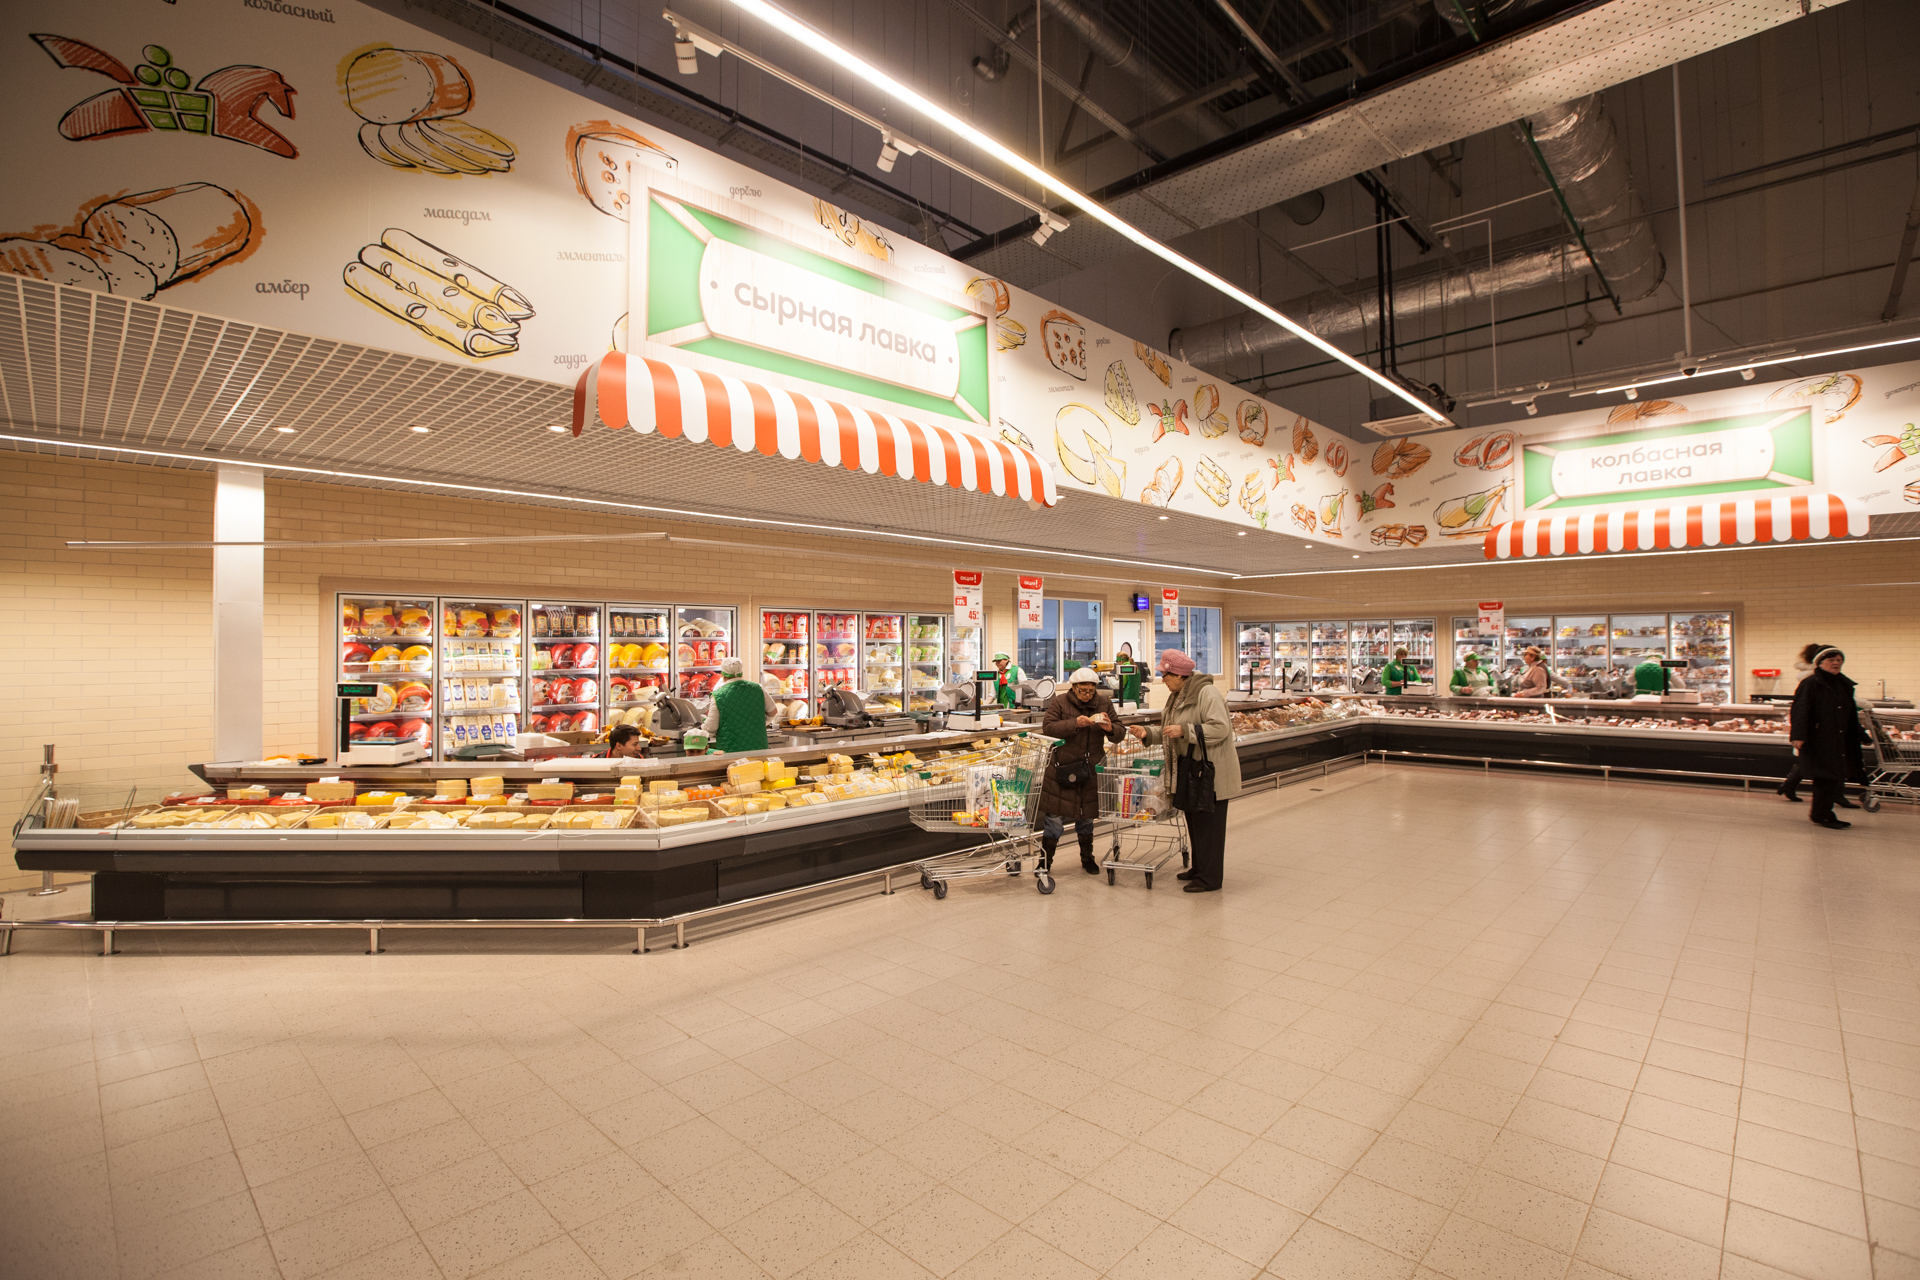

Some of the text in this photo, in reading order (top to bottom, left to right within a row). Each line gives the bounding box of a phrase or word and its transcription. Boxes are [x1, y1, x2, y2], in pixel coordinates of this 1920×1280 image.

[244, 0, 336, 23] колбасный
[729, 185, 762, 200] дорблю
[423, 207, 492, 226] маасдам
[556, 251, 626, 262] эмменталь
[255, 279, 310, 301] амбер
[734, 282, 936, 364] сырная лавка
[553, 353, 588, 370] гауда
[1591, 442, 1723, 469] колбасная
[1618, 465, 1692, 485] лавка
